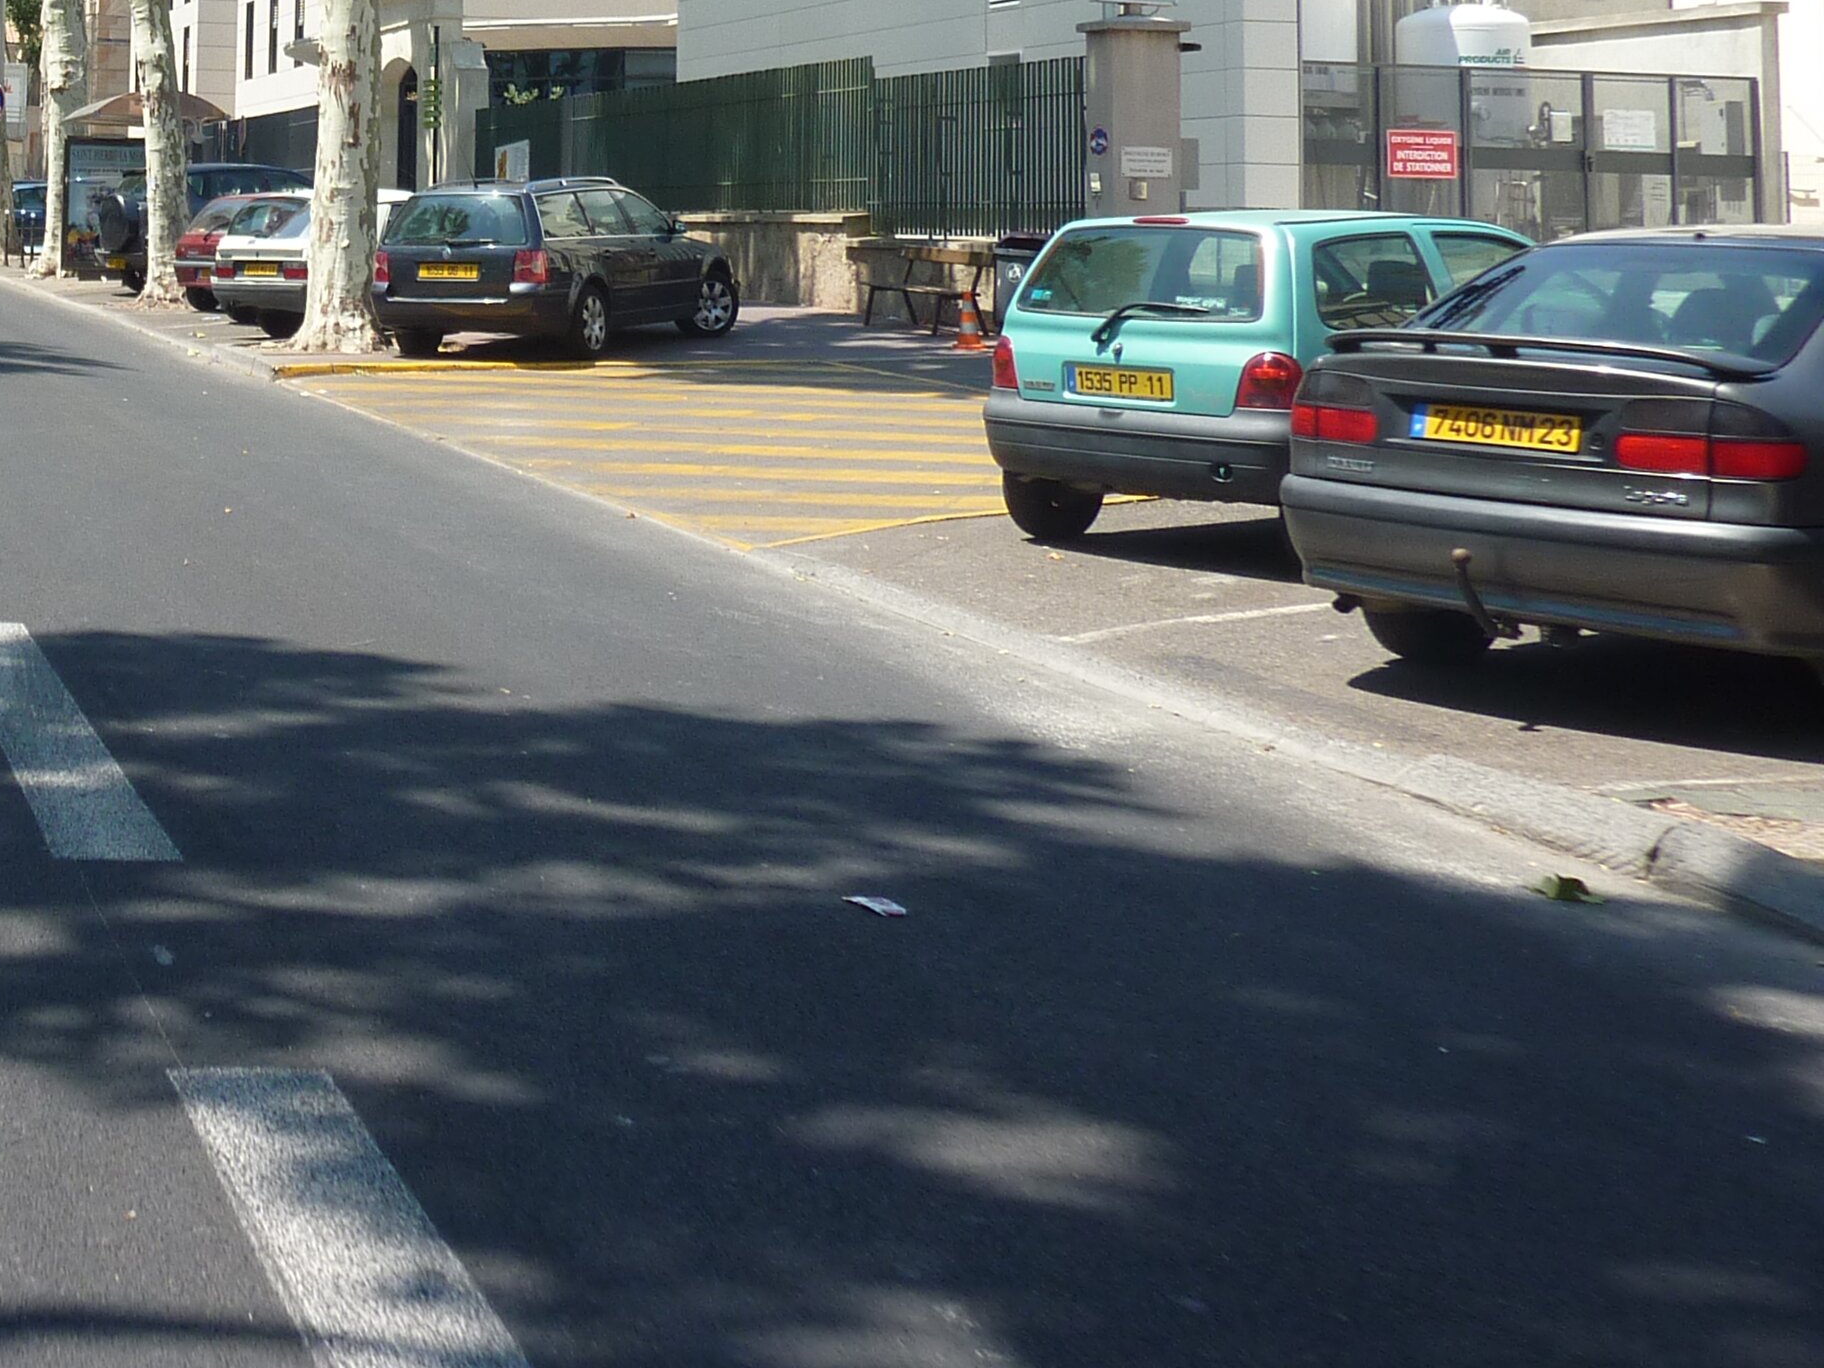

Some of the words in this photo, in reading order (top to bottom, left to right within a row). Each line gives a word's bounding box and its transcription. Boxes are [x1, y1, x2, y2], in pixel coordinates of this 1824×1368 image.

[1458, 56, 1511, 64] PRODUCTS
[1396, 150, 1448, 160] INTERDICTION
[1393, 162, 1403, 171] DE
[1406, 162, 1451, 172] STATIONNER
[1077, 371, 1112, 392] 1535
[1118, 373, 1138, 393] PP
[1146, 376, 1165, 395] 11
